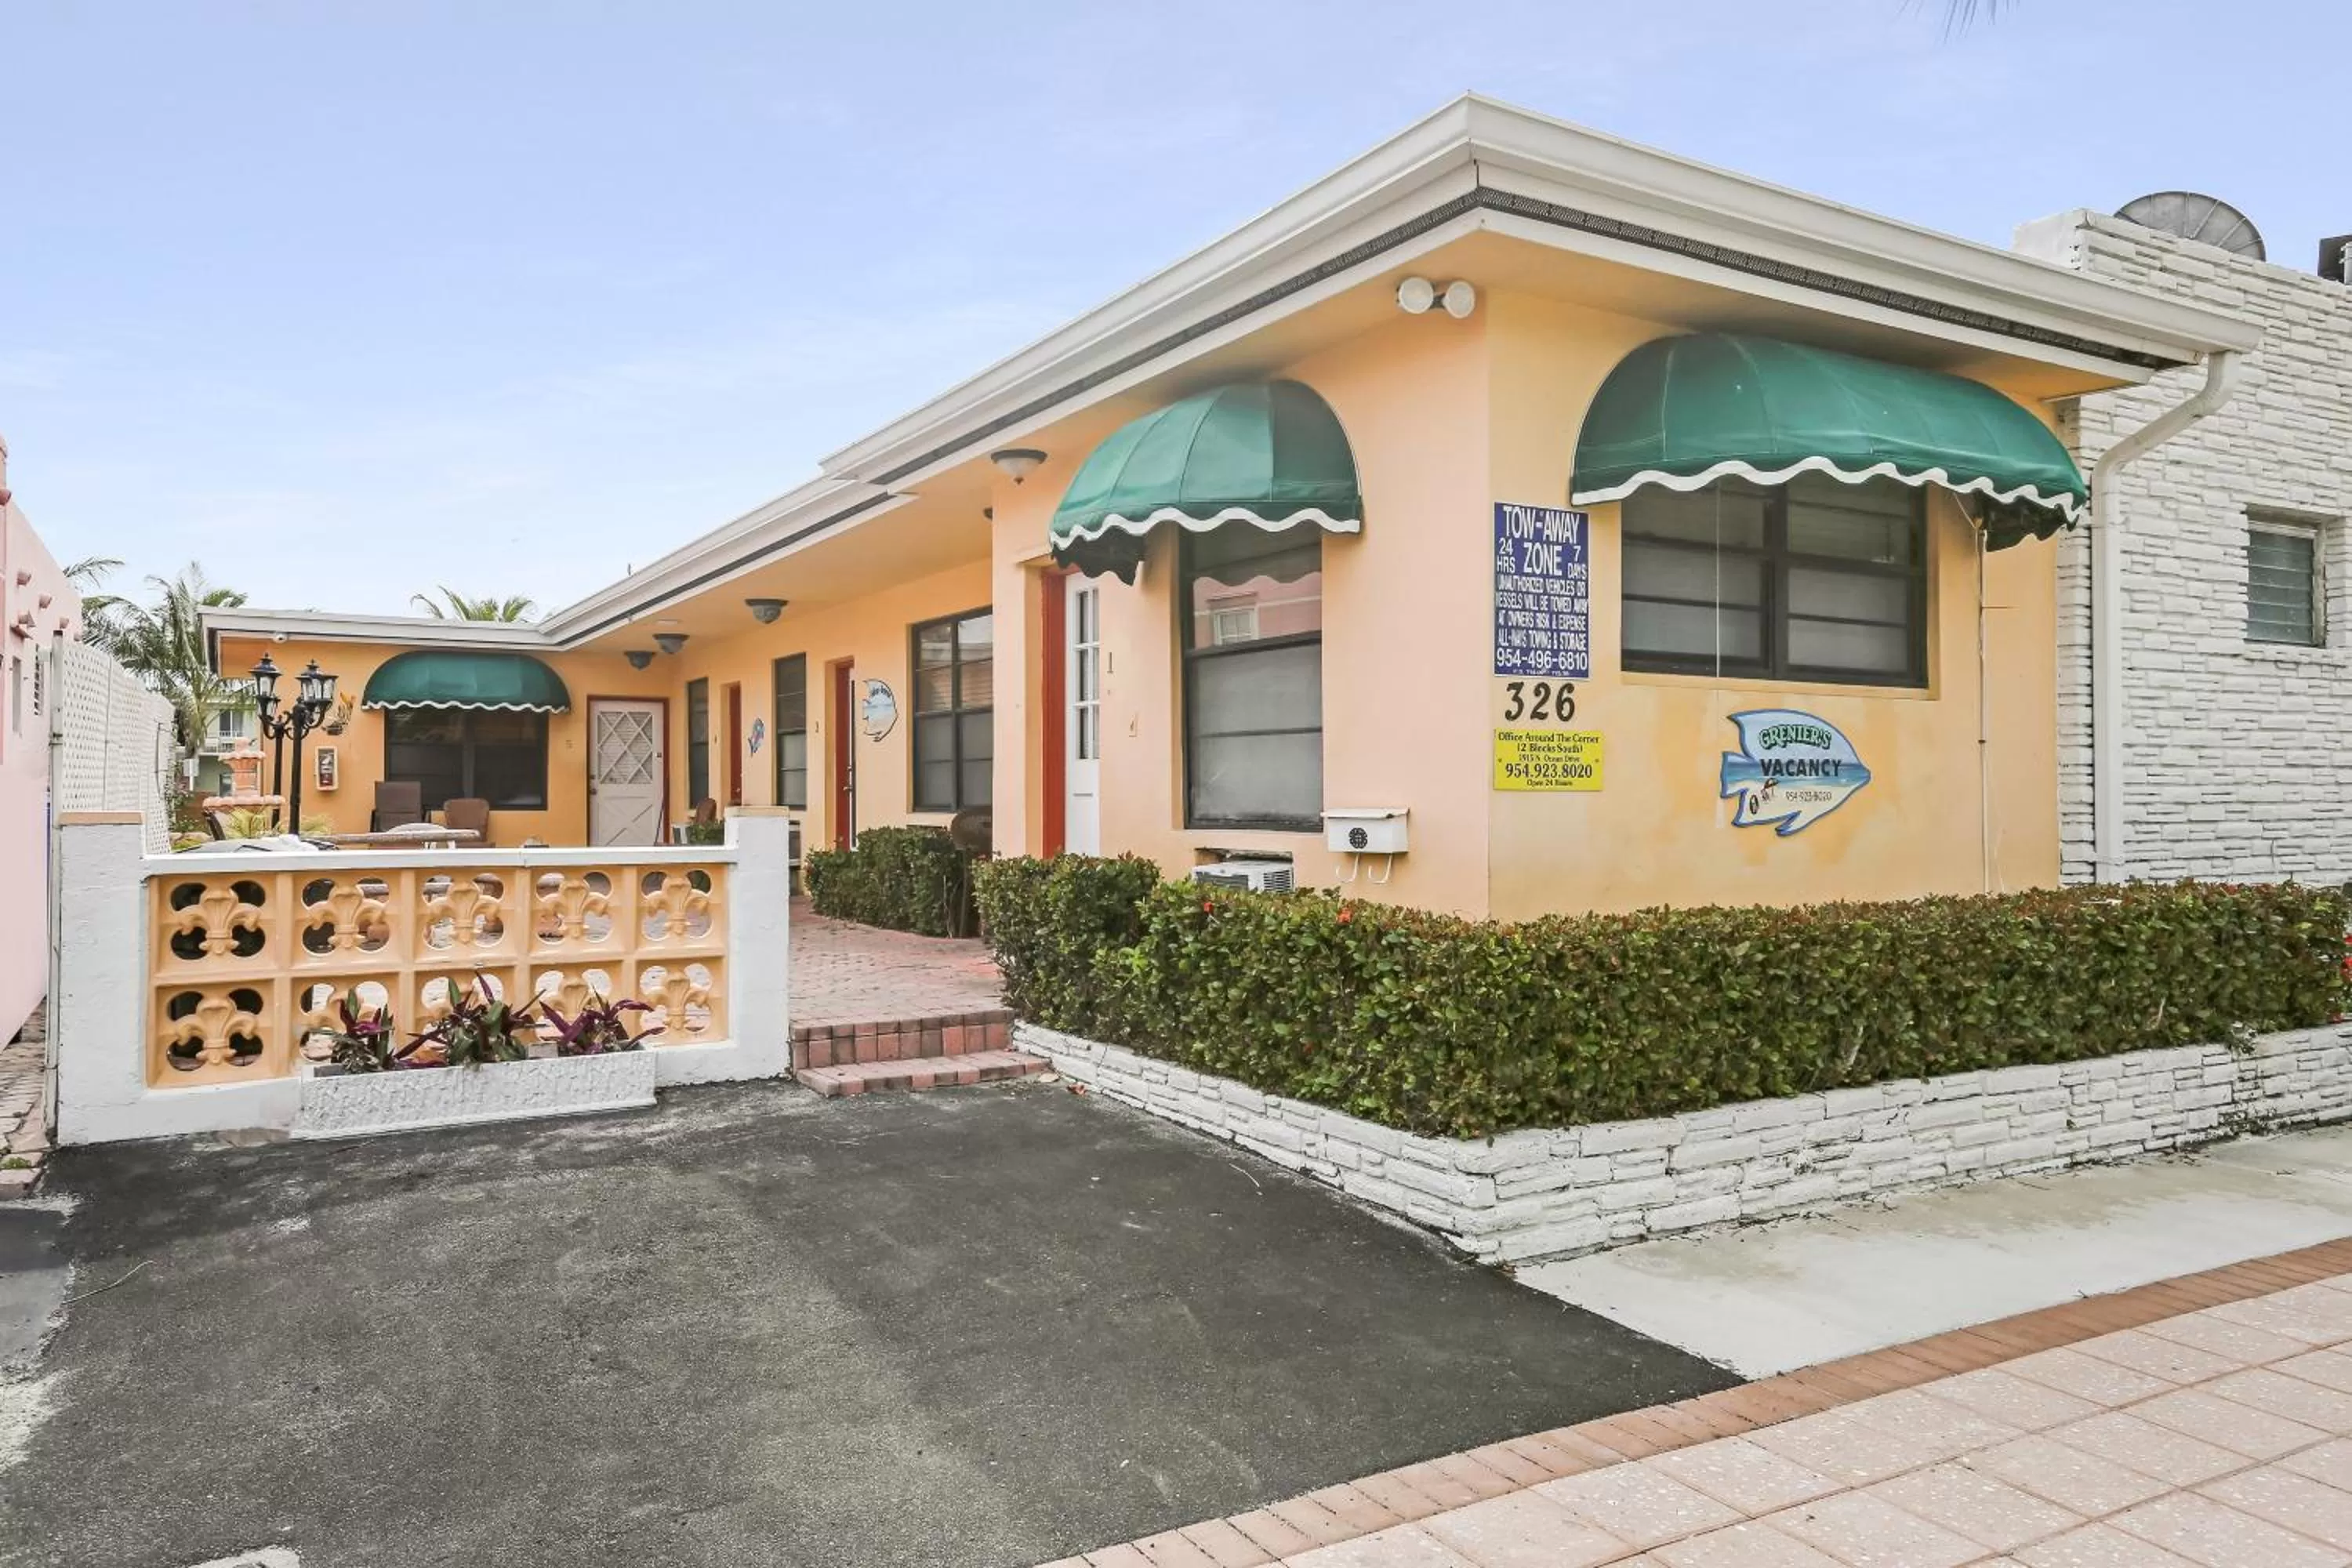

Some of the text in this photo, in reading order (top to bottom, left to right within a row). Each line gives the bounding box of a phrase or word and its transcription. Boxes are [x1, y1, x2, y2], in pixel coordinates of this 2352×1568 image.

[1503, 506, 1580, 543] TOW-AWAY
[1498, 538, 1513, 555] 24
[1573, 546, 1581, 561] 7
[1497, 556, 1515, 573] HRS
[1523, 543, 1563, 575] ZONE
[1567, 563, 1587, 579] DAYS
[1497, 575, 1586, 597] UNAUTHORIZED VEHICLES OR
[1495, 592, 1523, 609] VESSELS
[1523, 593, 1538, 611] WILL
[1540, 595, 1548, 611] BE
[1551, 596, 1572, 612] TOWED
[1498, 610, 1506, 626] AT
[1535, 612, 1550, 629] RISK
[1559, 614, 1586, 631] EXPENSE
[1528, 630, 1551, 649] TOWING
[1559, 632, 1586, 652] STORAGE
[1497, 648, 1588, 670] 954-496-6810
[1504, 681, 1575, 721] 326
[1497, 732, 1599, 744] Office Around The Corner
[1759, 724, 1832, 750] GRENIER'S
[1530, 743, 1555, 753] Blocks
[1505, 763, 1592, 779] 954.923.8020
[1760, 758, 1842, 777] VACANCY
